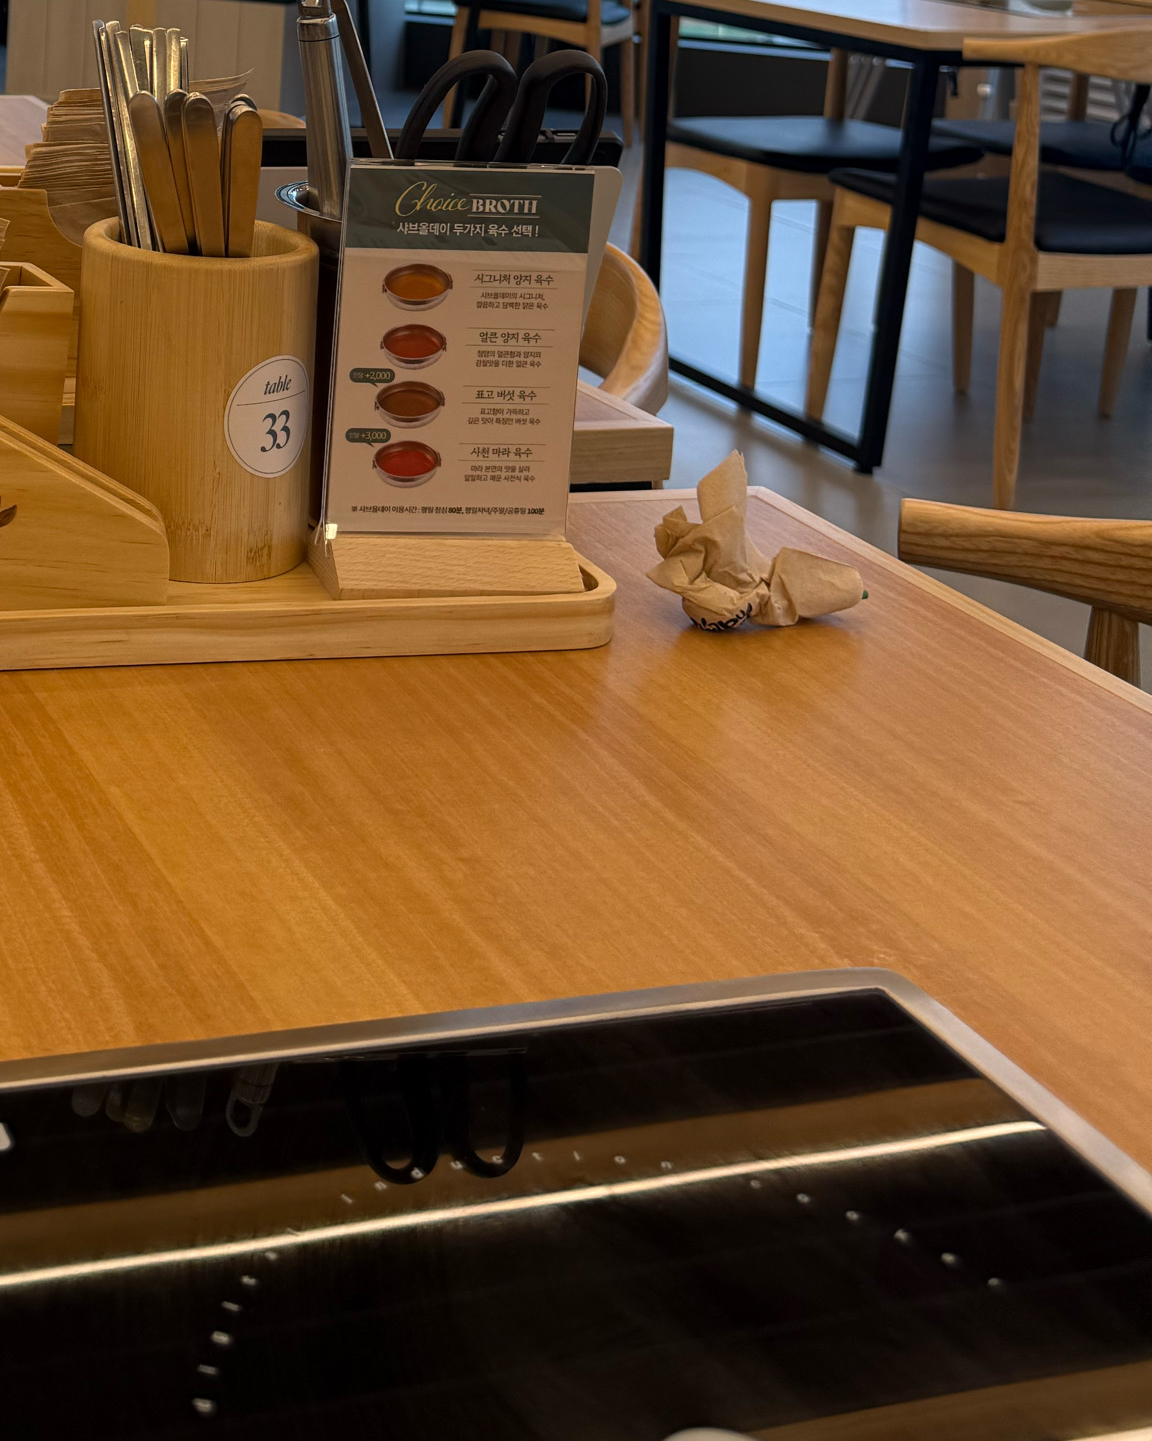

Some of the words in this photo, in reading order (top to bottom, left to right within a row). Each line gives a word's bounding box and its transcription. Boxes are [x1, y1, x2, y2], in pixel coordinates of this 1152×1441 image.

[395, 181, 470, 217] Choice
[471, 198, 538, 214] BROTH
[397, 222, 450, 236] 샤브올데이
[453, 223, 485, 237] 두가지
[488, 224, 509, 237] 육수
[511, 224, 533, 238] 선택
[474, 273, 511, 285] 시그니처
[513, 274, 532, 285] 양지
[533, 274, 555, 286] 육수
[479, 331, 498, 343] 얼큰
[500, 331, 519, 344] 양지
[521, 332, 542, 344] 육수
[364, 371, 391, 381] +2,000
[263, 375, 292, 396] table
[475, 389, 495, 400] 표고
[496, 389, 515, 402] 버섯
[517, 390, 537, 402] 육수
[260, 409, 291, 453] 33
[361, 431, 387, 441] +3,000
[470, 446, 490, 459] 사천
[492, 446, 511, 458] 마라
[513, 447, 533, 459] 육수
